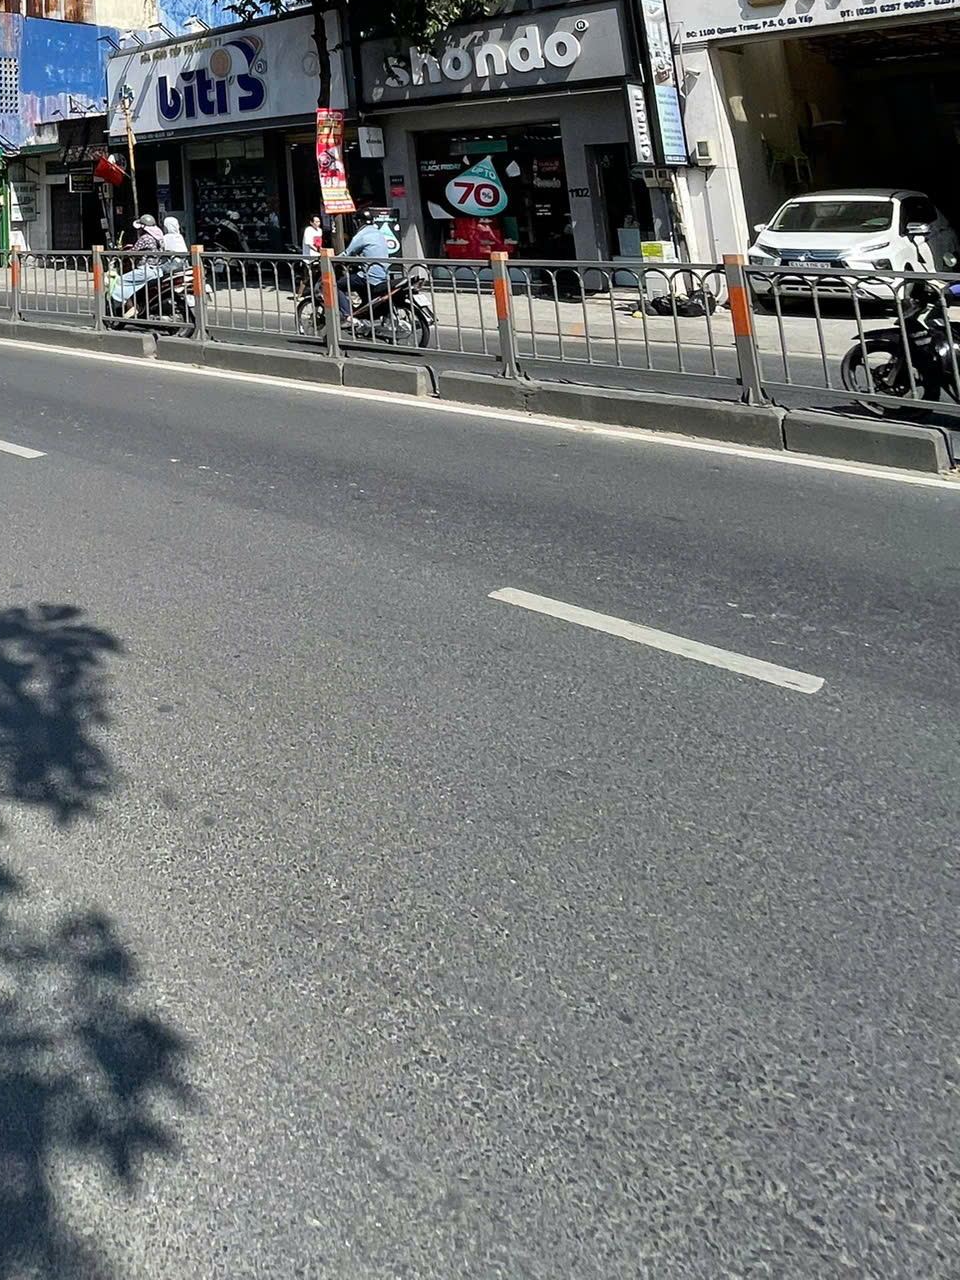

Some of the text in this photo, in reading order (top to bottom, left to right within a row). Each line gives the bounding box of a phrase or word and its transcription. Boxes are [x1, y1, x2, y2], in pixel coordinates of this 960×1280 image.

[699, 28, 715, 37] 1100
[383, 23, 582, 88] shondo
[157, 69, 265, 120] biti's
[471, 166, 497, 180] UP TO
